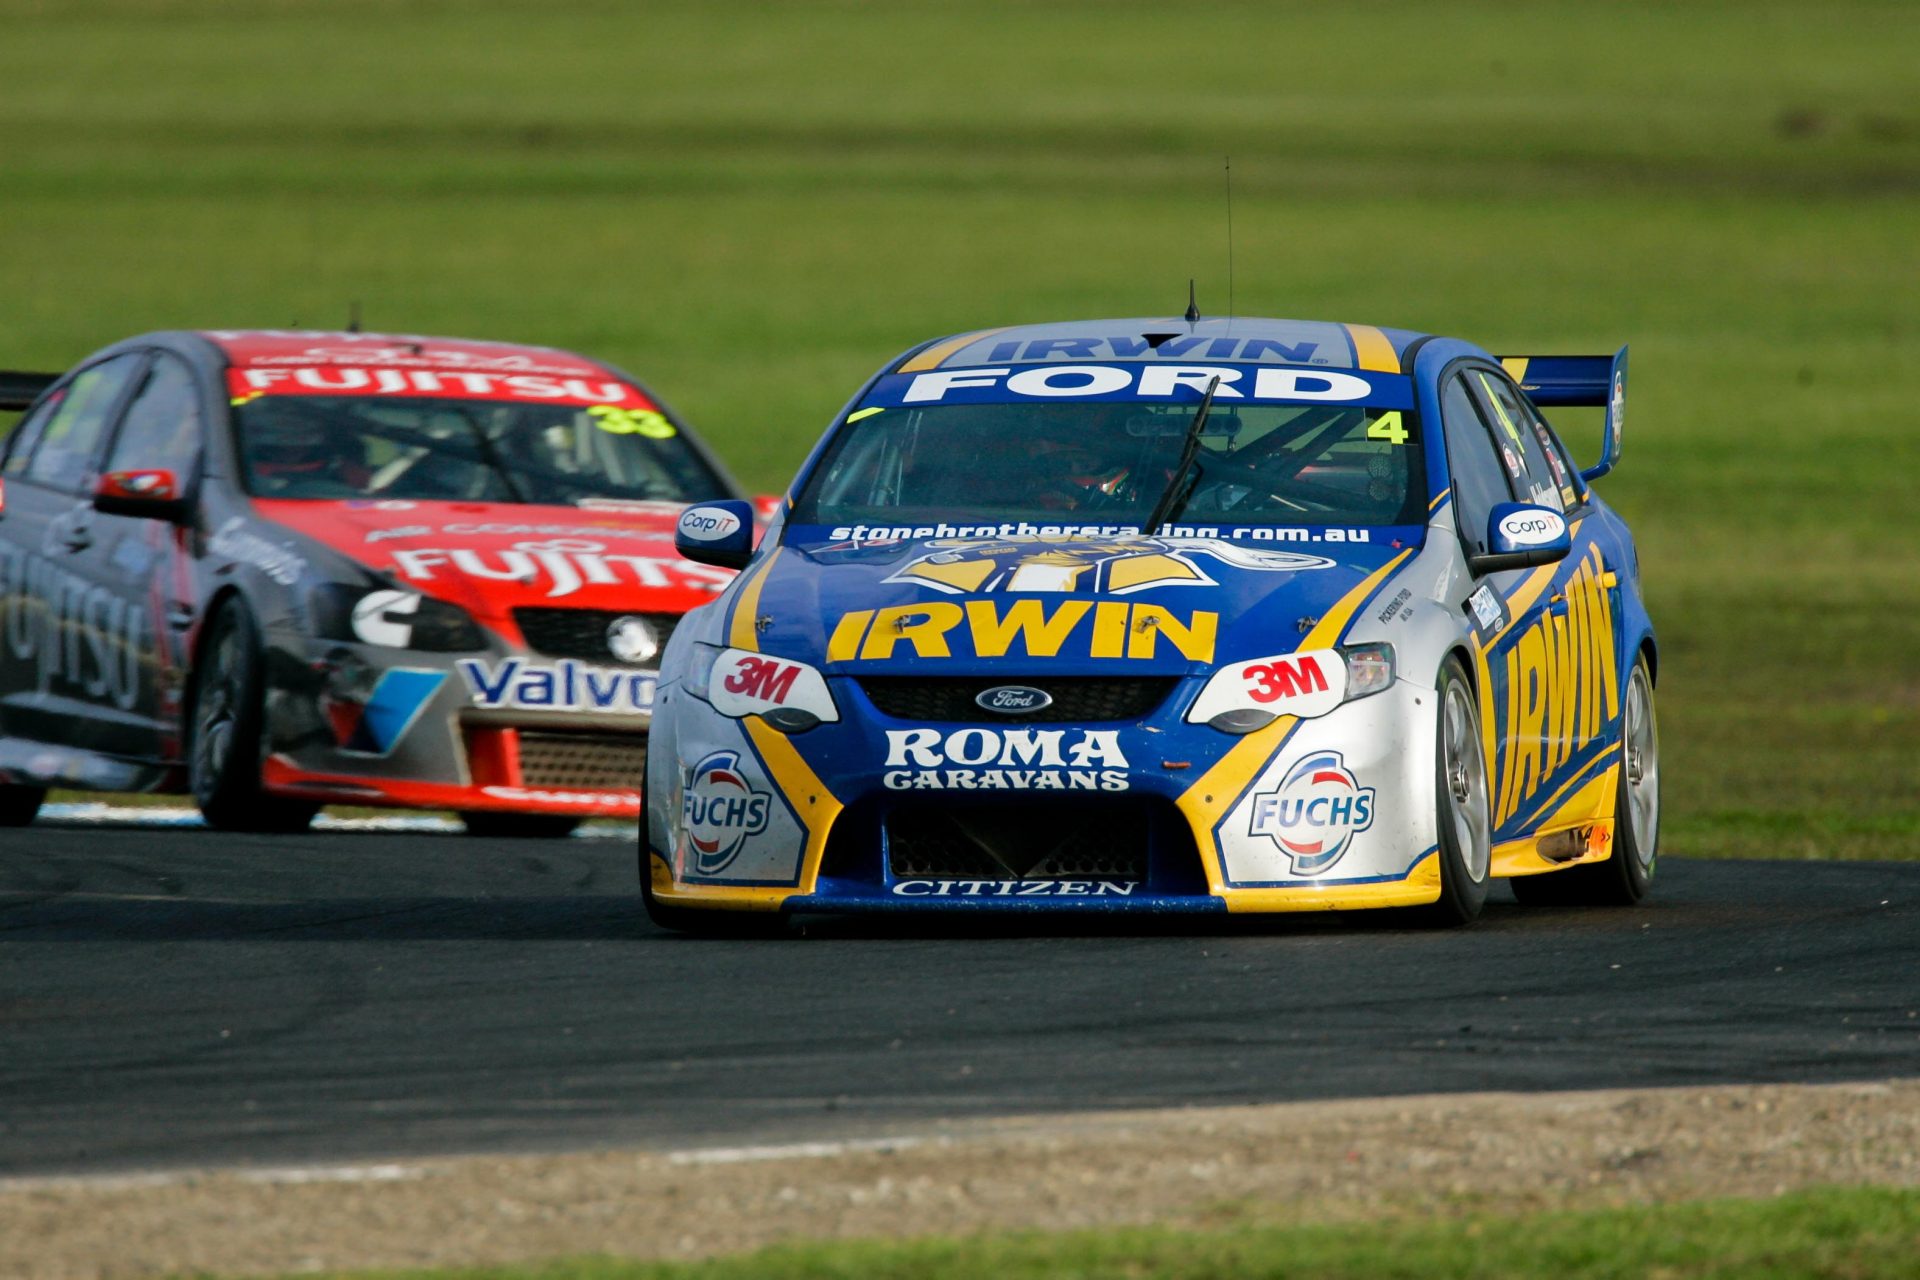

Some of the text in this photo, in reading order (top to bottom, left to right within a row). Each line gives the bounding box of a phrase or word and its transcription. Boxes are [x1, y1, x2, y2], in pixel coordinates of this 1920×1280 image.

[988, 336, 1319, 364] IRWIN
[243, 367, 627, 403] FUJITSU
[903, 365, 1371, 402] FORD
[1367, 411, 1408, 444] 4
[826, 601, 1218, 664] IRWIN
[724, 656, 802, 705] 3M
[1243, 656, 1329, 704] 3M
[1495, 542, 1619, 832] IRWIN
[992, 689, 1033, 709] Ford
[885, 728, 1130, 768] ROMA
[883, 769, 1130, 792] CARAVANS
[683, 796, 768, 829] FUCHS
[1256, 795, 1370, 830] FUCHS
[892, 880, 1140, 897] CITIZEN
